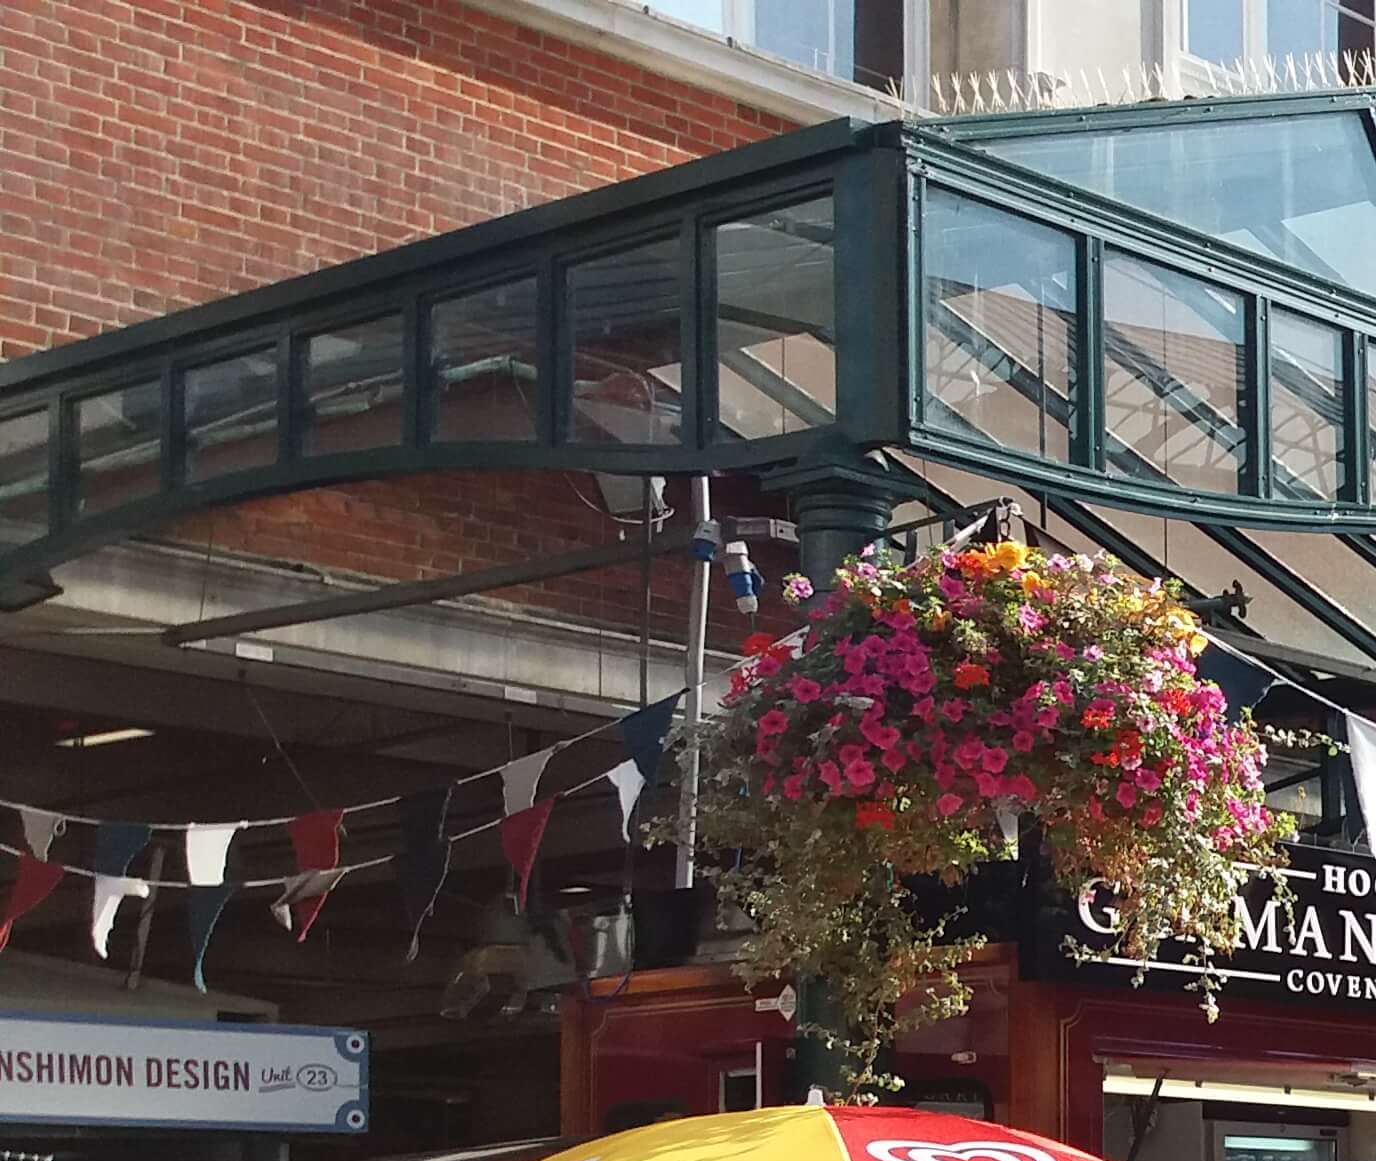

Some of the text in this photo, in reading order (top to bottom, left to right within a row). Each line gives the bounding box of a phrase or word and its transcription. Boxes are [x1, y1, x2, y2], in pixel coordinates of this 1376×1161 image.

[146, 1058, 251, 1091] DESIGN
[261, 1066, 293, 1084] Unit
[306, 1072, 328, 1087] 23
